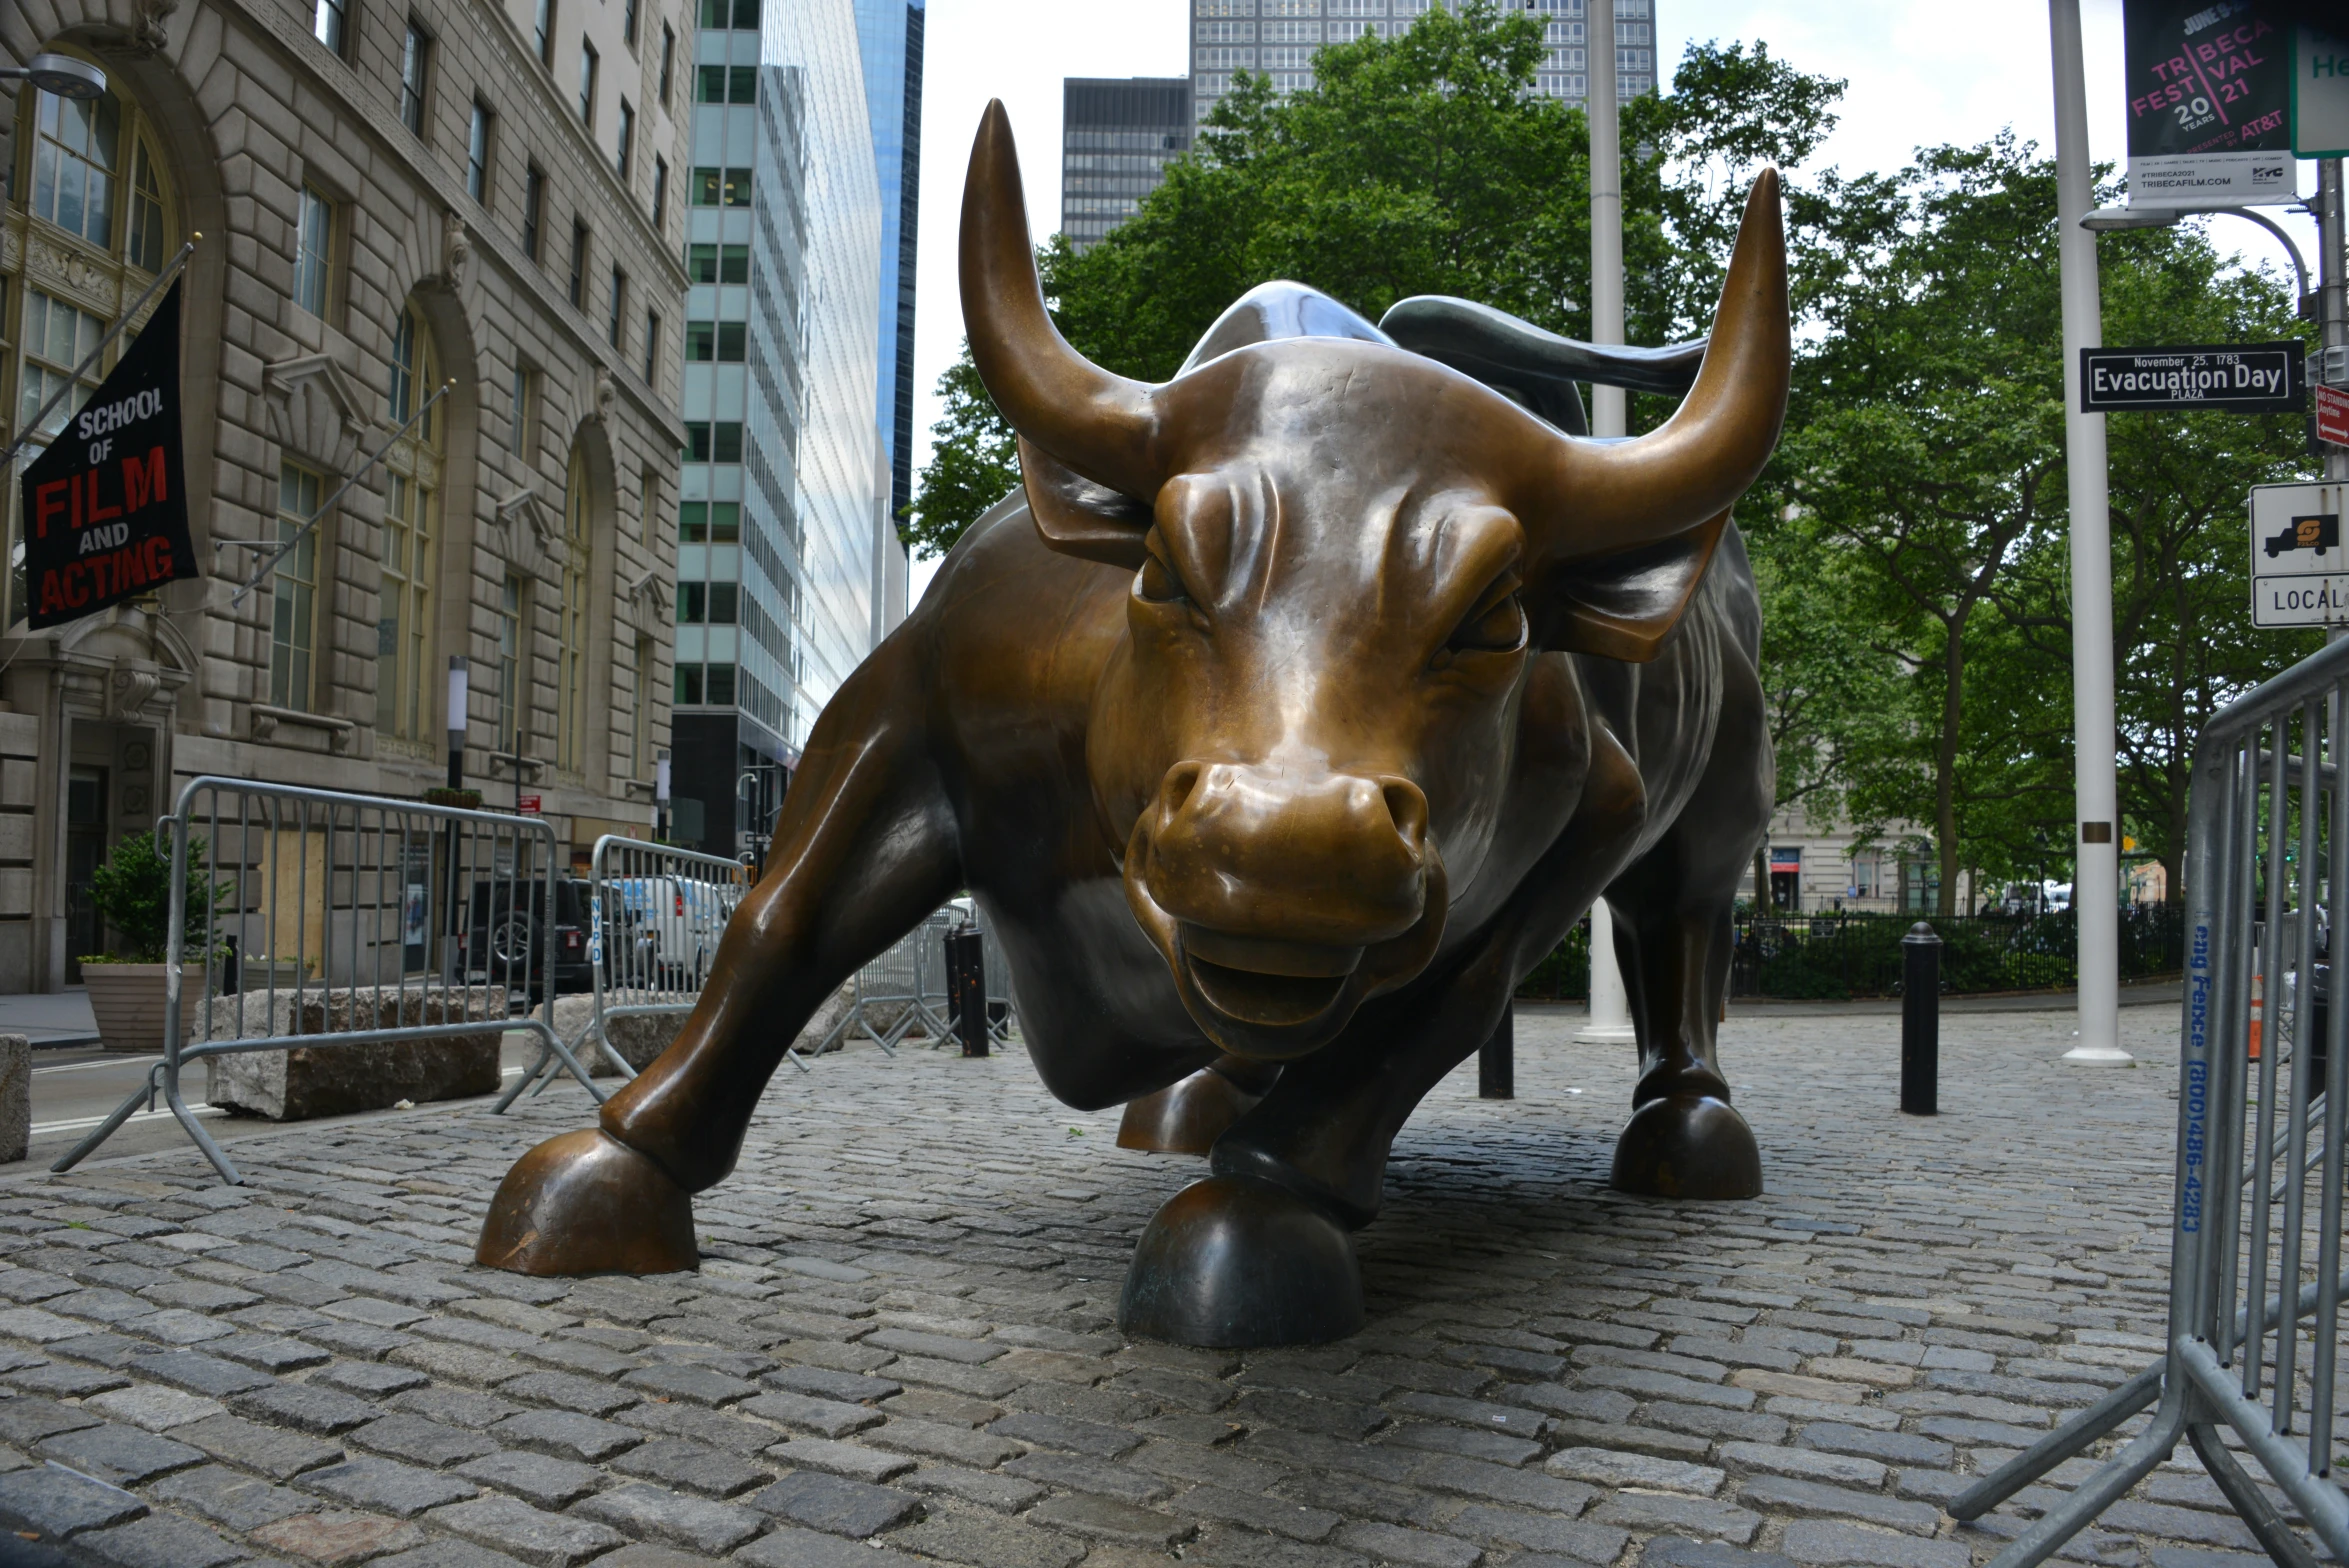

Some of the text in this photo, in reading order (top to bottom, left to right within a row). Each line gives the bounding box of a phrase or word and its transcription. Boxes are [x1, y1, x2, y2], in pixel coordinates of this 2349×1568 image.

[2183, 6, 2221, 36] JUNE
[2174, 96, 2210, 125] 20
[2182, 113, 2216, 132] YEARS
[2241, 109, 2284, 141] AT&T
[2186, 130, 2236, 155] PRESENTED
[2227, 137, 2239, 148] BY
[2141, 170, 2195, 179] #TRIBECA2021
[2141, 177, 2231, 189] TRIBECAFILM.COM
[2134, 356, 2185, 368] November
[2216, 354, 2240, 366] 1783
[2094, 363, 2281, 393] Evacuation Day
[2171, 389, 2204, 400] PLAZA
[2318, 390, 2327, 402] NO
[78, 387, 163, 440] SCHOOL
[2319, 402, 2341, 418] Anytime
[89, 438, 113, 465] OF
[36, 446, 167, 539] FILM
[78, 522, 129, 555] AND
[38, 535, 173, 615] ACTING
[2274, 589, 2343, 611] LOCAL
[591, 898, 602, 962] NYPD
[2191, 974, 2211, 1048] Fence
